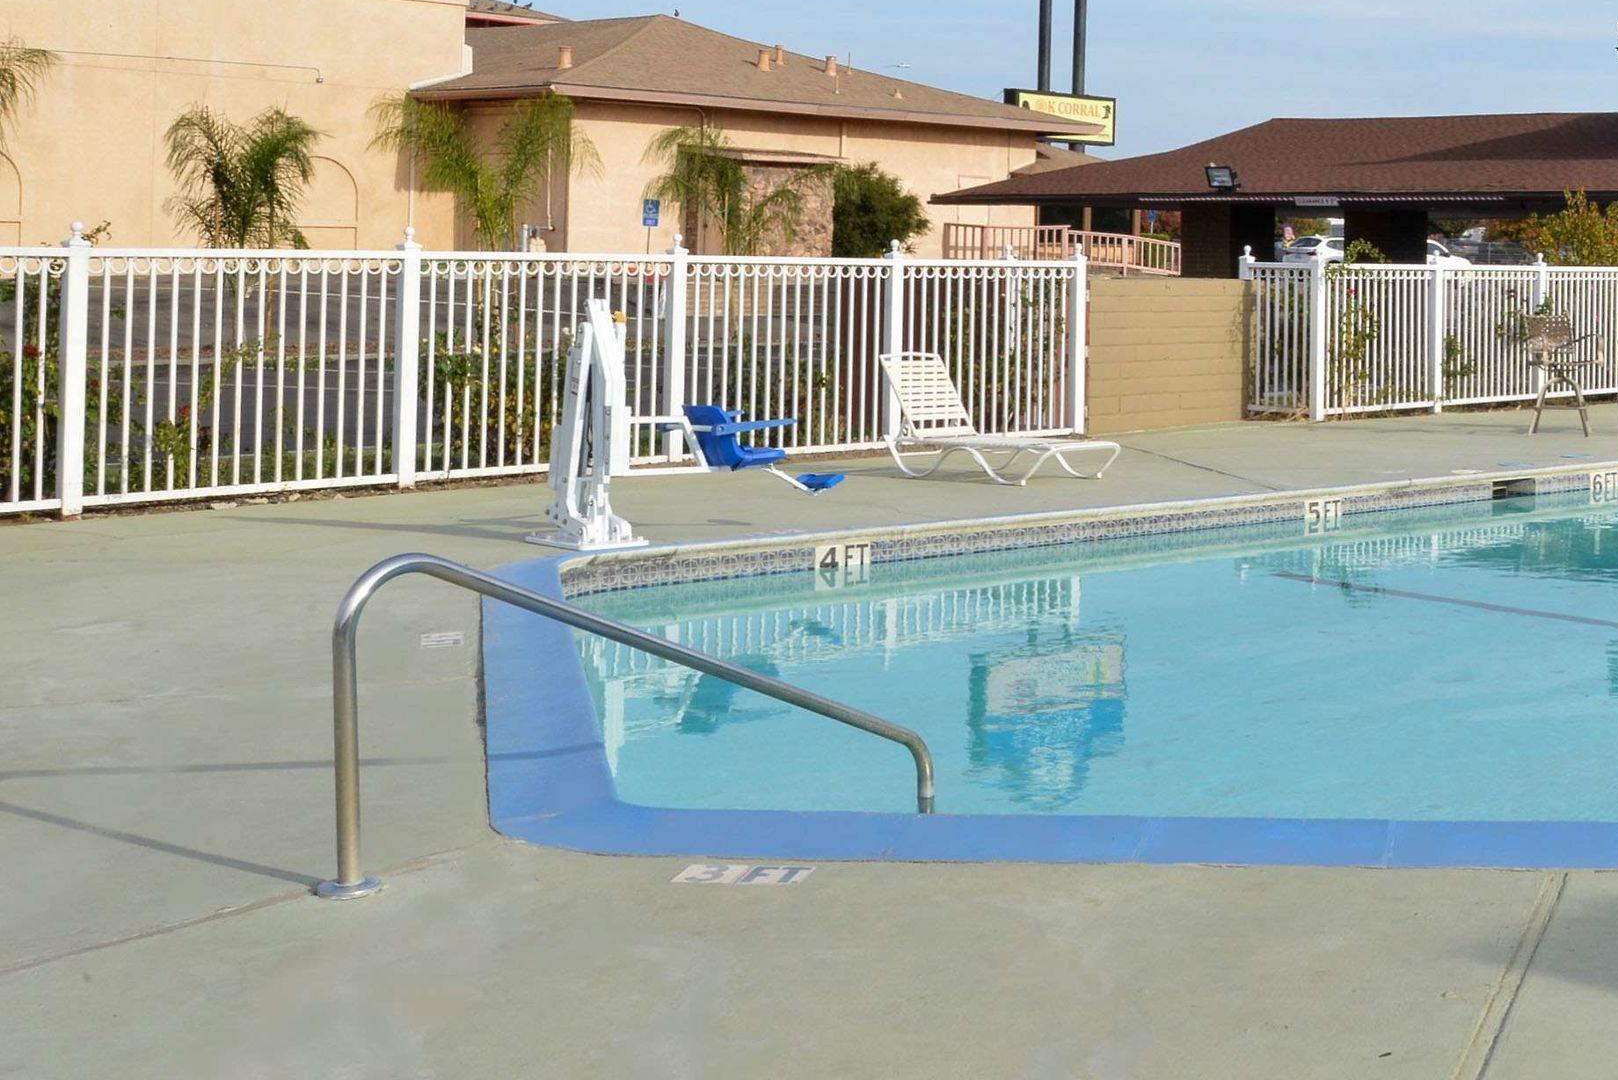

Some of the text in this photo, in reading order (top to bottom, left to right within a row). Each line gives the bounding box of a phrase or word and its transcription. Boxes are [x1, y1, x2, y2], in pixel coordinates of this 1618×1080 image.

[1057, 101, 1101, 118] CORRAL
[1593, 472, 1617, 491] 6 FT
[1308, 500, 1341, 521] 5 FT
[819, 543, 869, 568] 4 FT
[684, 865, 813, 883] 3 FT
